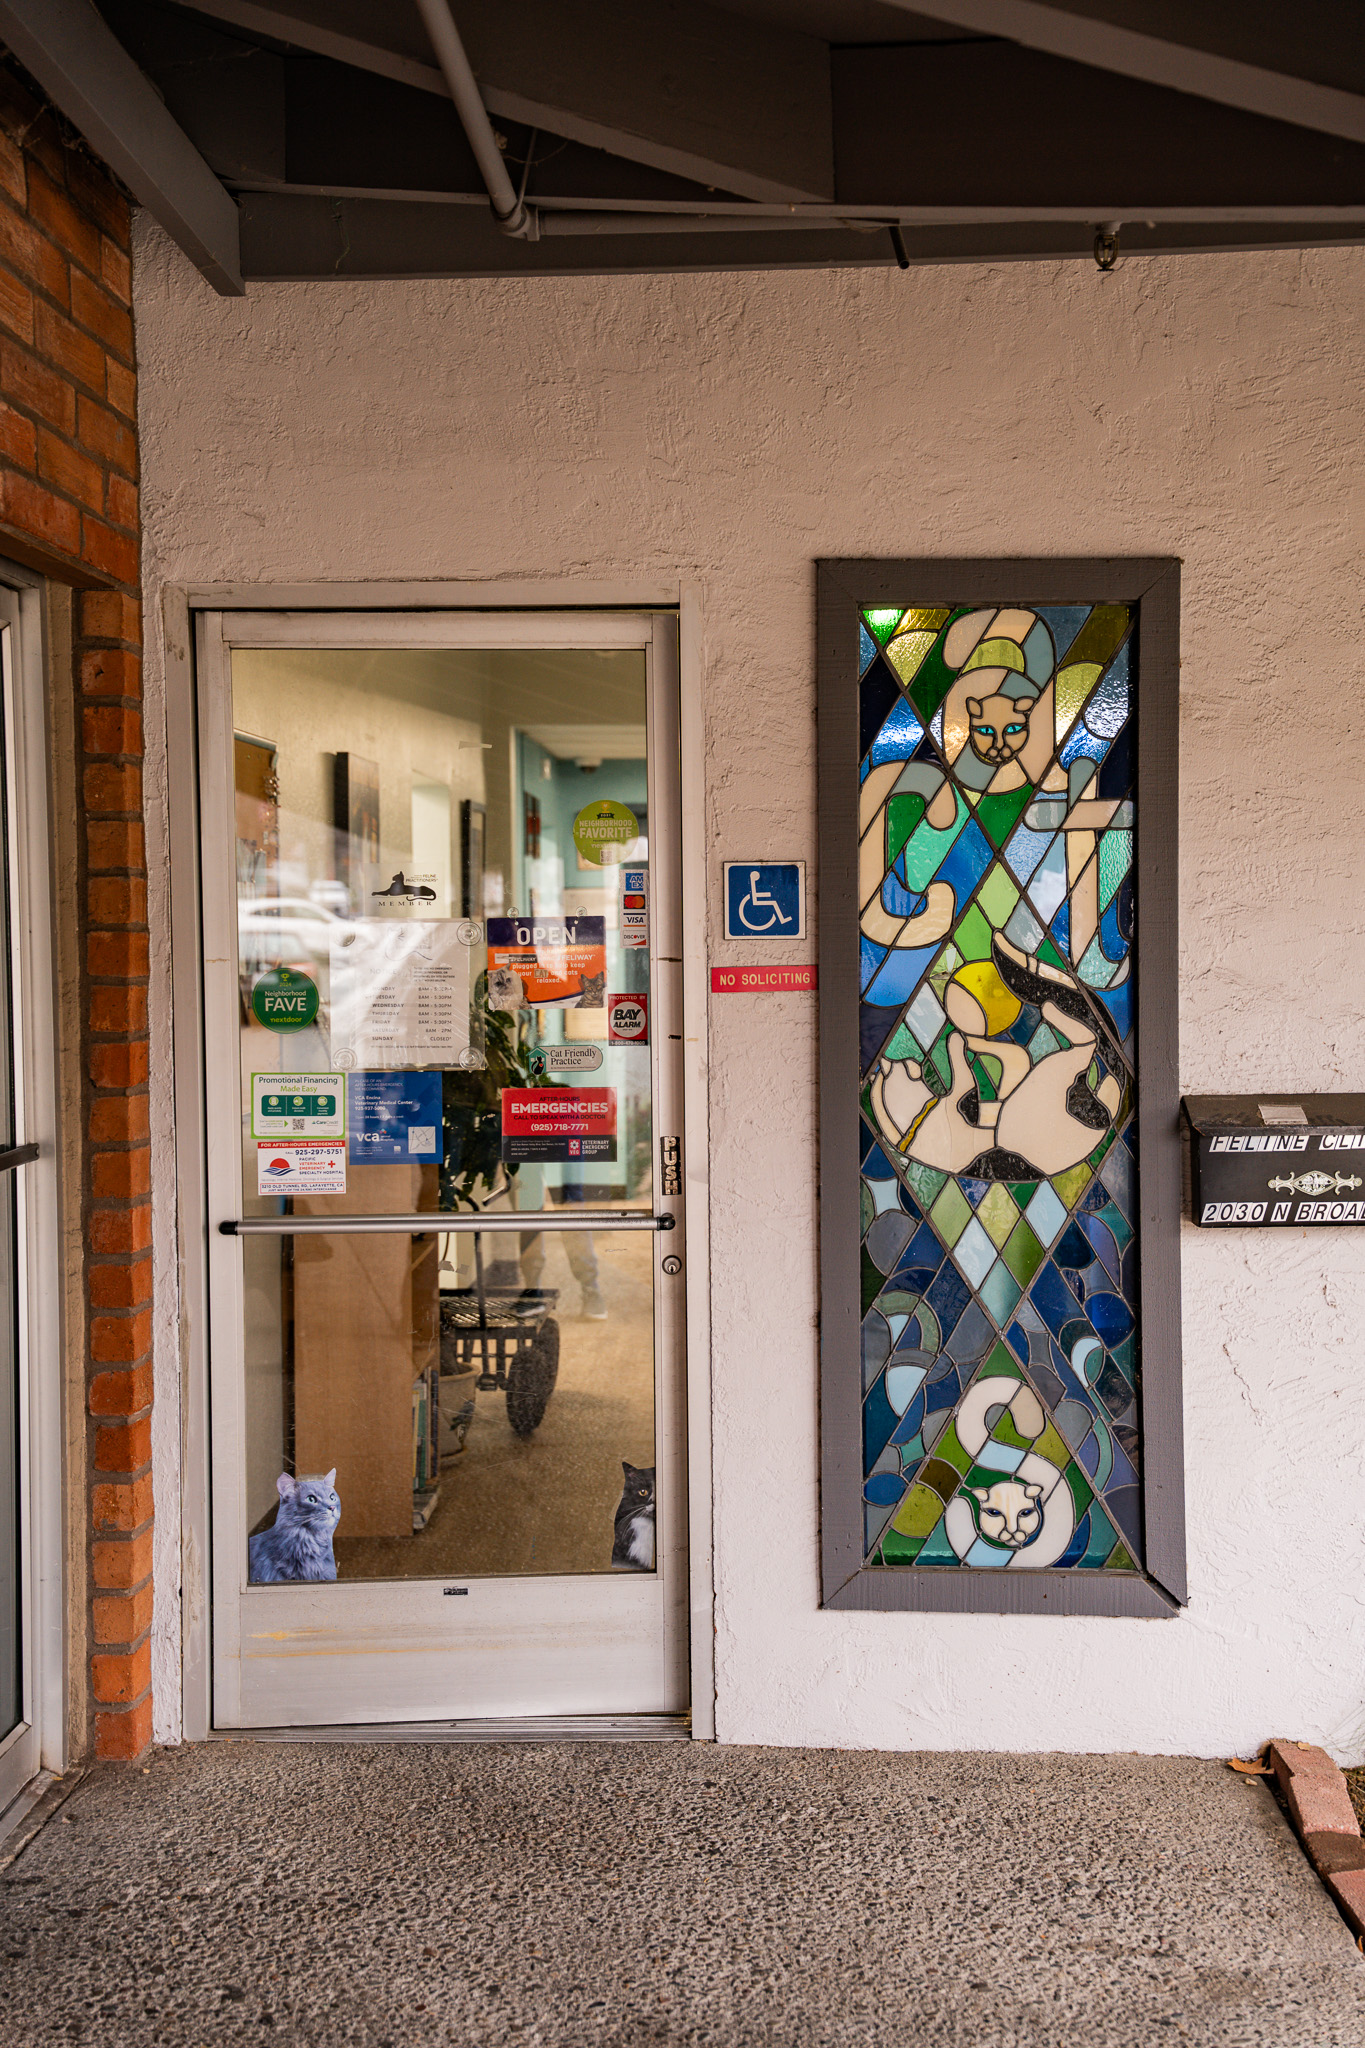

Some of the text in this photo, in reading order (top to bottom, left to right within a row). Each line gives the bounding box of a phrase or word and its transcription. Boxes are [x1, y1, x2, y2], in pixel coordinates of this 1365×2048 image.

[579, 827, 632, 838] FAVORITE
[516, 926, 577, 946] OPEN
[720, 972, 811, 986] NO SOLICITING
[264, 990, 307, 998] Neighborhood
[265, 997, 307, 1012] FAVE
[613, 1008, 642, 1021] BAY
[550, 1049, 596, 1058] Cat Friendly
[550, 1058, 582, 1066] Practice
[304, 1077, 338, 1085] Financing
[511, 1102, 609, 1114] EMERGENCIES
[531, 1123, 589, 1132] (925) 718-7771
[356, 1132, 380, 1142] vca
[1213, 1136, 1307, 1151] FELINE
[663, 1136, 679, 1195] PUSH
[1205, 1203, 1264, 1221] 2030
[1274, 1203, 1290, 1221] N
